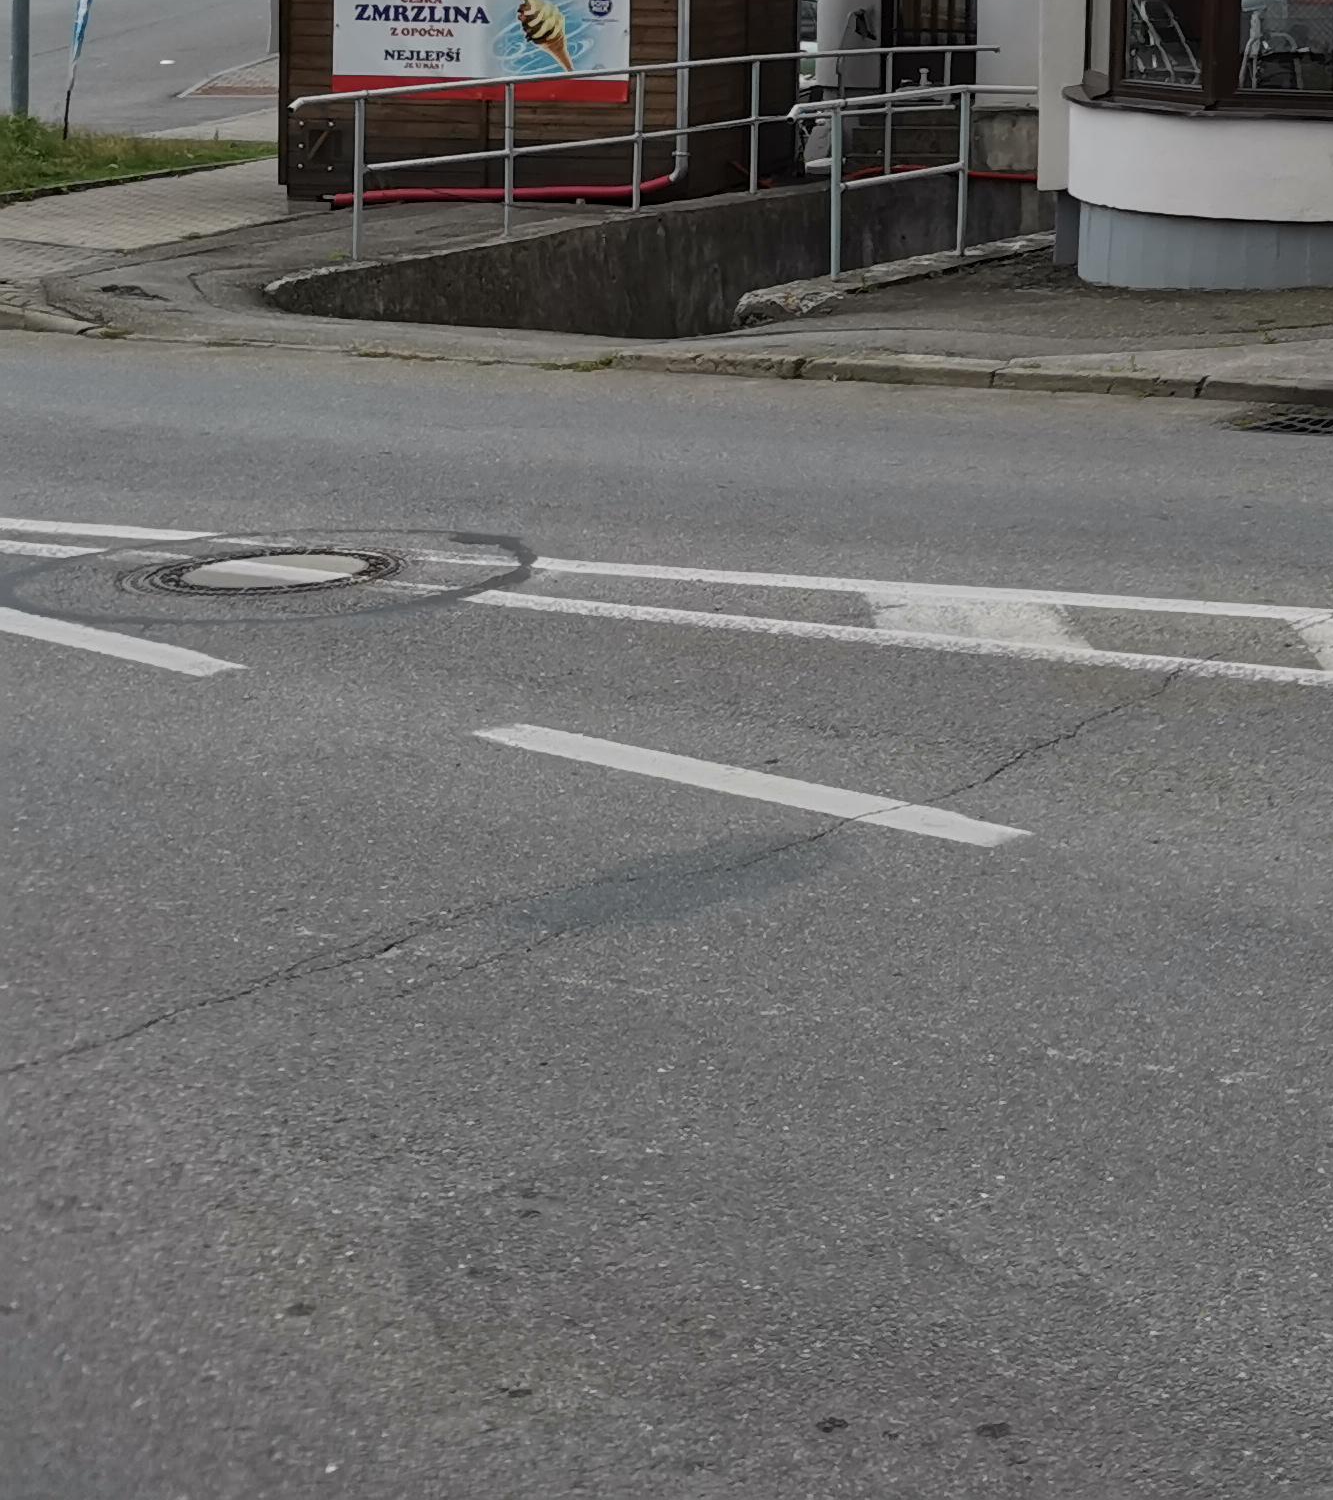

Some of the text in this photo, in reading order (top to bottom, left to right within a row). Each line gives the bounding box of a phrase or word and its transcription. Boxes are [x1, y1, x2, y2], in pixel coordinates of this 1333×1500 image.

[354, 4, 490, 25] ZMRZLINA
[390, 26, 454, 38] Z OPOČNA
[384, 48, 461, 63] NEJLEPŠÍ
